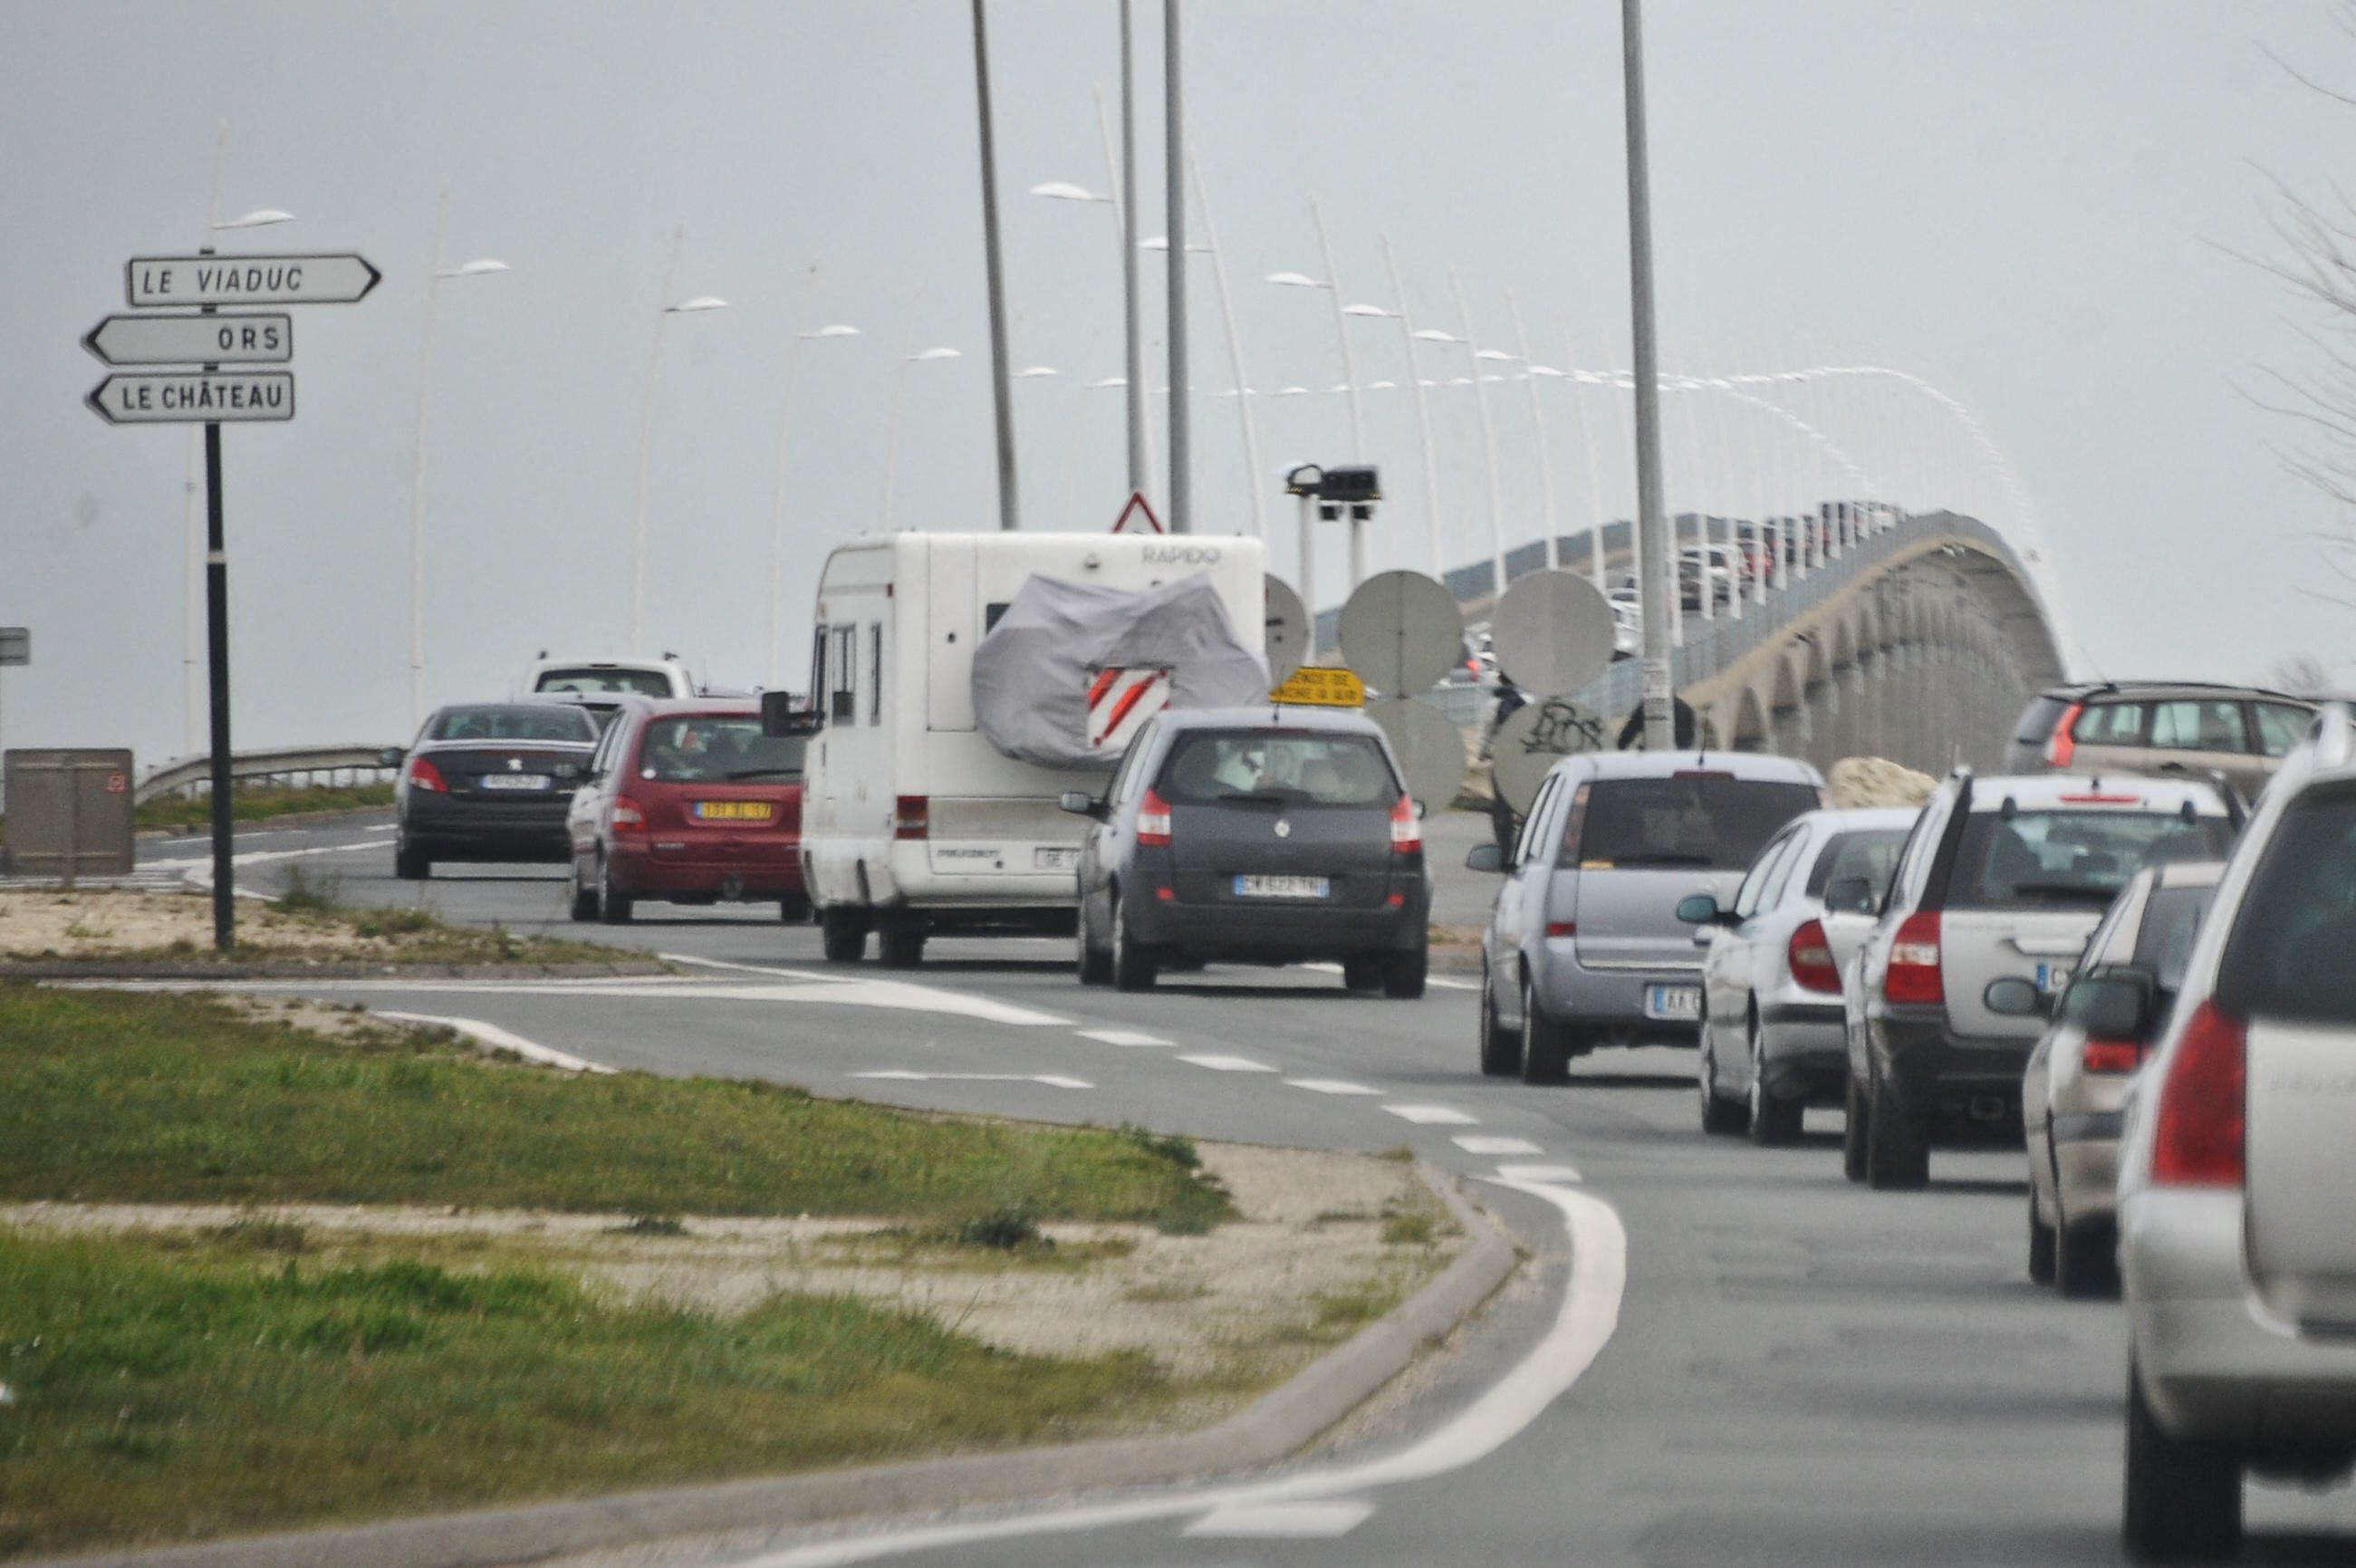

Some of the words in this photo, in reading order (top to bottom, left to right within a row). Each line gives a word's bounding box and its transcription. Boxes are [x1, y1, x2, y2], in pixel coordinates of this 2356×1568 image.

[142, 270, 173, 294] LE
[197, 266, 304, 293] VIADUC
[217, 326, 280, 351] ORS
[122, 385, 151, 410] LE
[161, 380, 283, 410] CHÂTEAU
